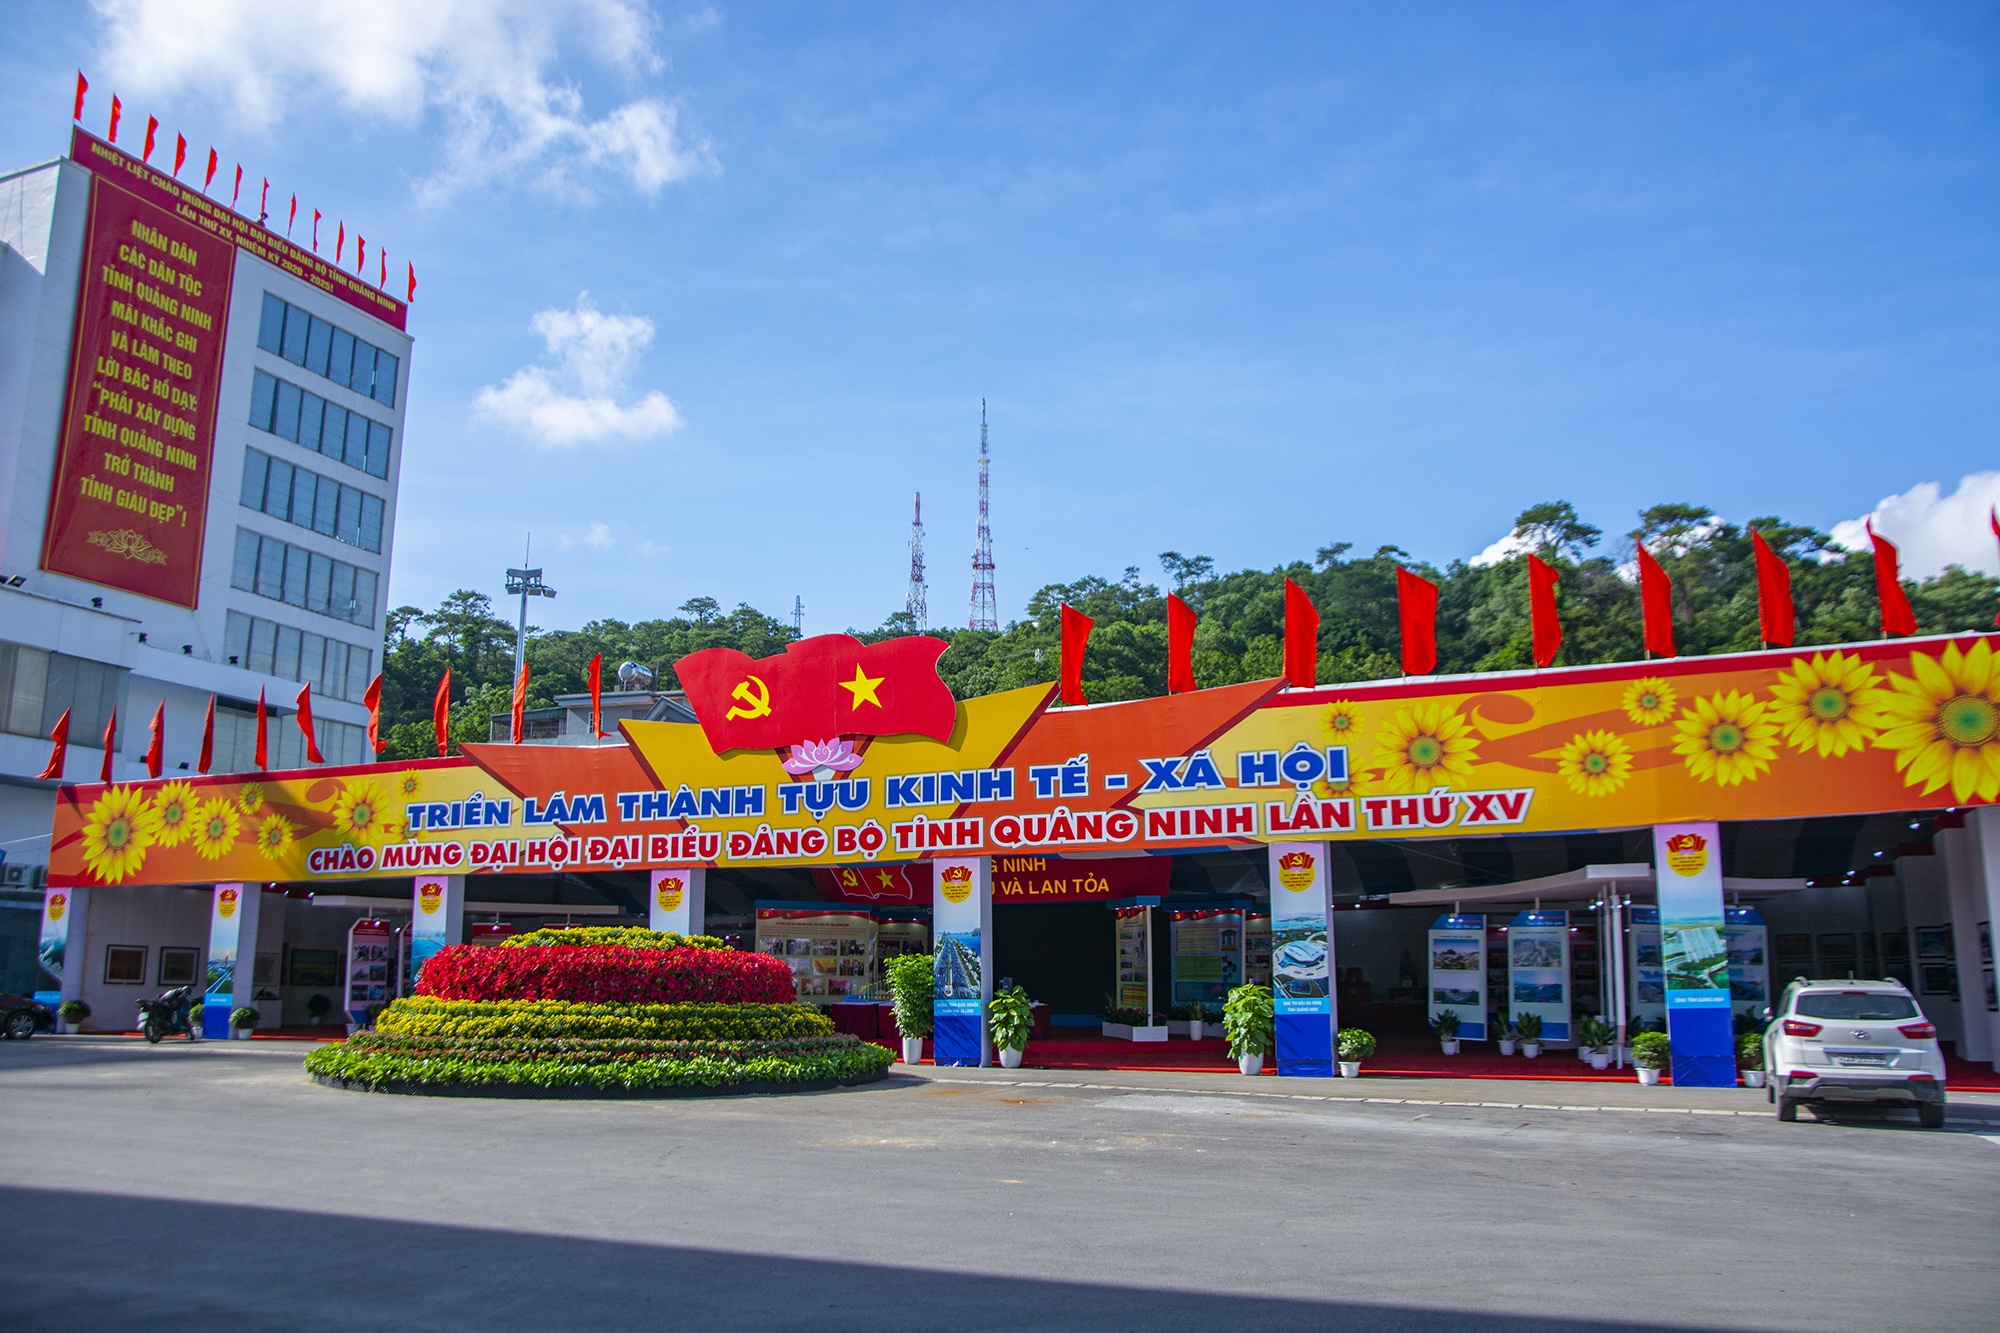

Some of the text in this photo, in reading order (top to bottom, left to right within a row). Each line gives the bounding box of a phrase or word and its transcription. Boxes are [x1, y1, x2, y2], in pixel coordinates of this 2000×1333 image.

[90, 141, 397, 314] NHIỆT LIỆT CHÀO MỪNG ĐẠI HỘI ĐẠI BIỂU ĐẢNG BỘ TỈNH QUẢNG NINH
[131, 219, 198, 267] NHÂN DÂN
[198, 213, 218, 233] THỨ
[235, 233, 267, 258] NHIỆM
[267, 251, 280, 265] KỲ
[281, 258, 304, 278] 2020
[309, 273, 334, 293] 2025!
[119, 244, 202, 297] CÁC DÂN TỘC
[102, 263, 212, 332] TỈNH QUẢNG NINH
[111, 300, 197, 354] MÃI KHẮC GHI
[110, 329, 193, 380] VÀ LÀM THEO
[96, 355, 198, 413] LỜI BÁC HỒ DẠY:
[83, 410, 198, 472] TỈNH QUẢNG NINH
[134, 401, 162, 426] XÂY
[162, 413, 197, 441] DỰNG
[80, 472, 114, 503] TỈNH
[115, 489, 148, 515] GIÀU
[103, 451, 175, 493] TRỞ THÀNH
[405, 742, 1348, 831] TRIỂN LÃM THÀNH TỰU KINH TẾ - XÃ HỘI
[308, 788, 1532, 872] CHÀO MỪNG ĐẠI HỘI ĐẠI BIỂU ĐẢNG BỘ TỈNH QUẢNG NINH LẦN THỨ XV
[1001, 876, 1024, 895] VÀ
[1028, 879, 1067, 895] LAN
[1072, 872, 1110, 893] TỎA
[1003, 857, 1047, 873] NINH
